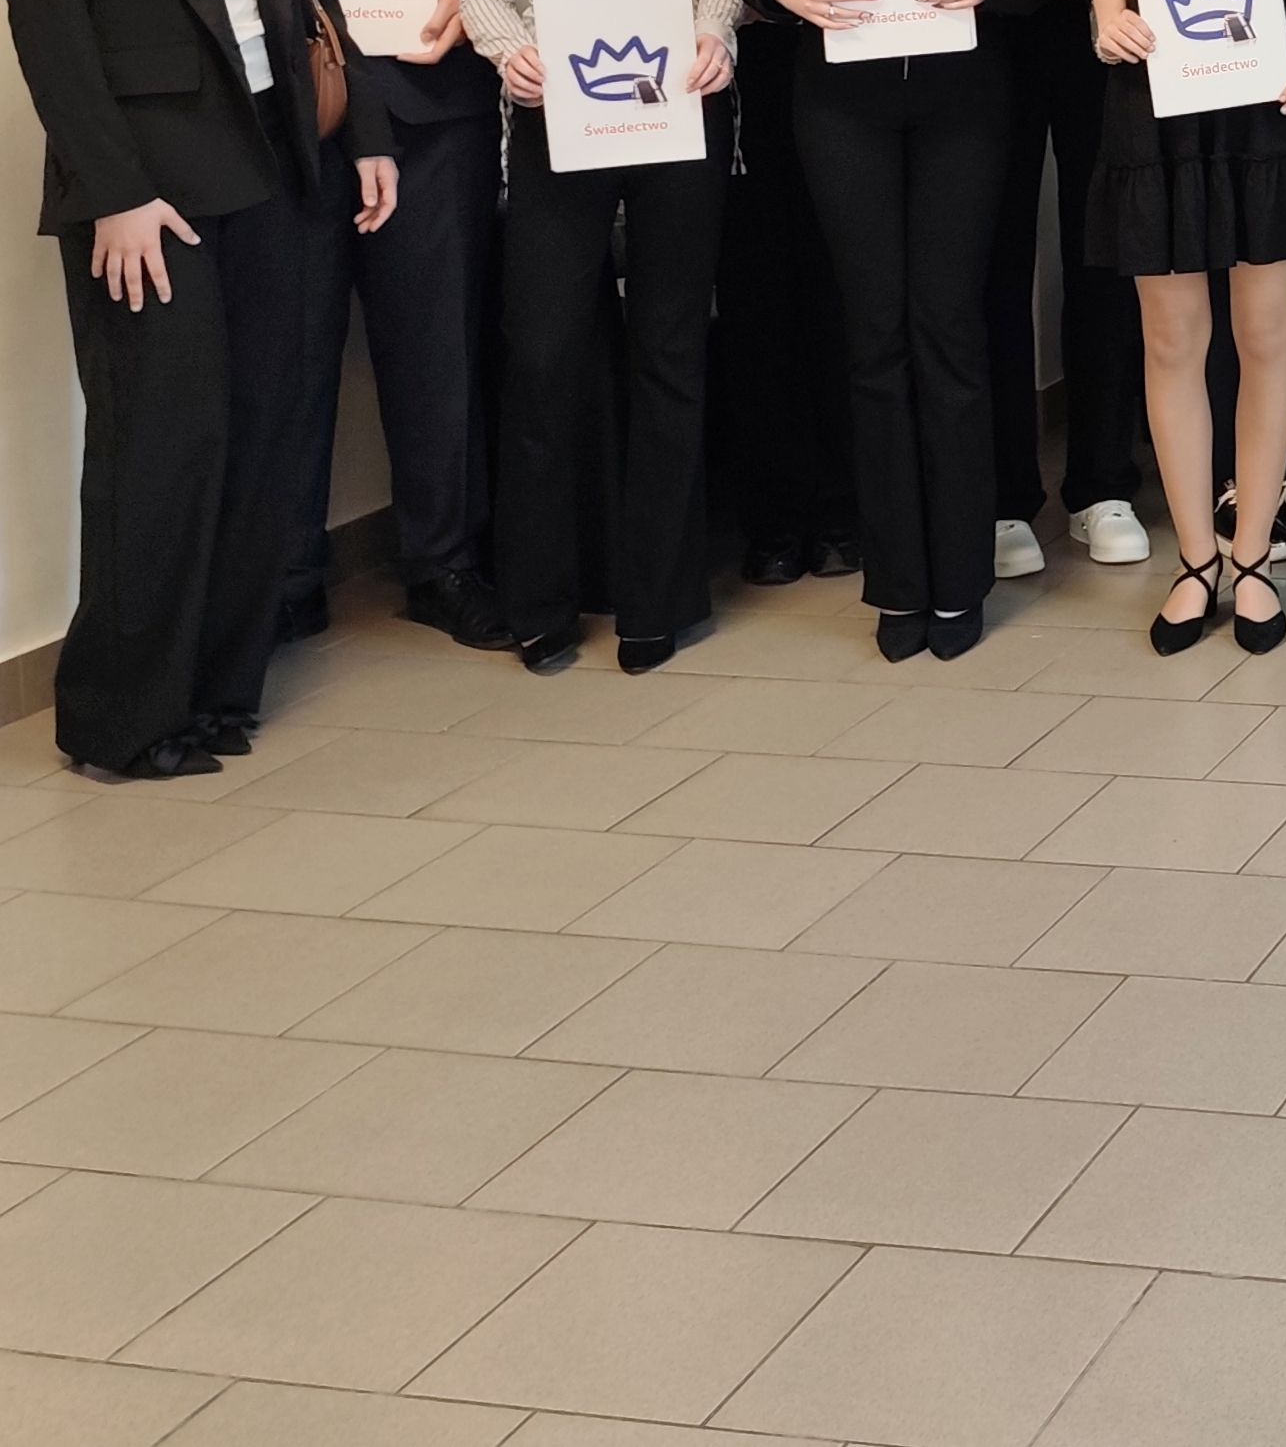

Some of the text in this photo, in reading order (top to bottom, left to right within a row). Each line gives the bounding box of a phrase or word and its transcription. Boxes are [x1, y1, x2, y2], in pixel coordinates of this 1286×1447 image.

[344, 7, 404, 18] adectwo
[1181, 58, 1259, 78] Świadectwo
[584, 120, 669, 136] Świadectwo
